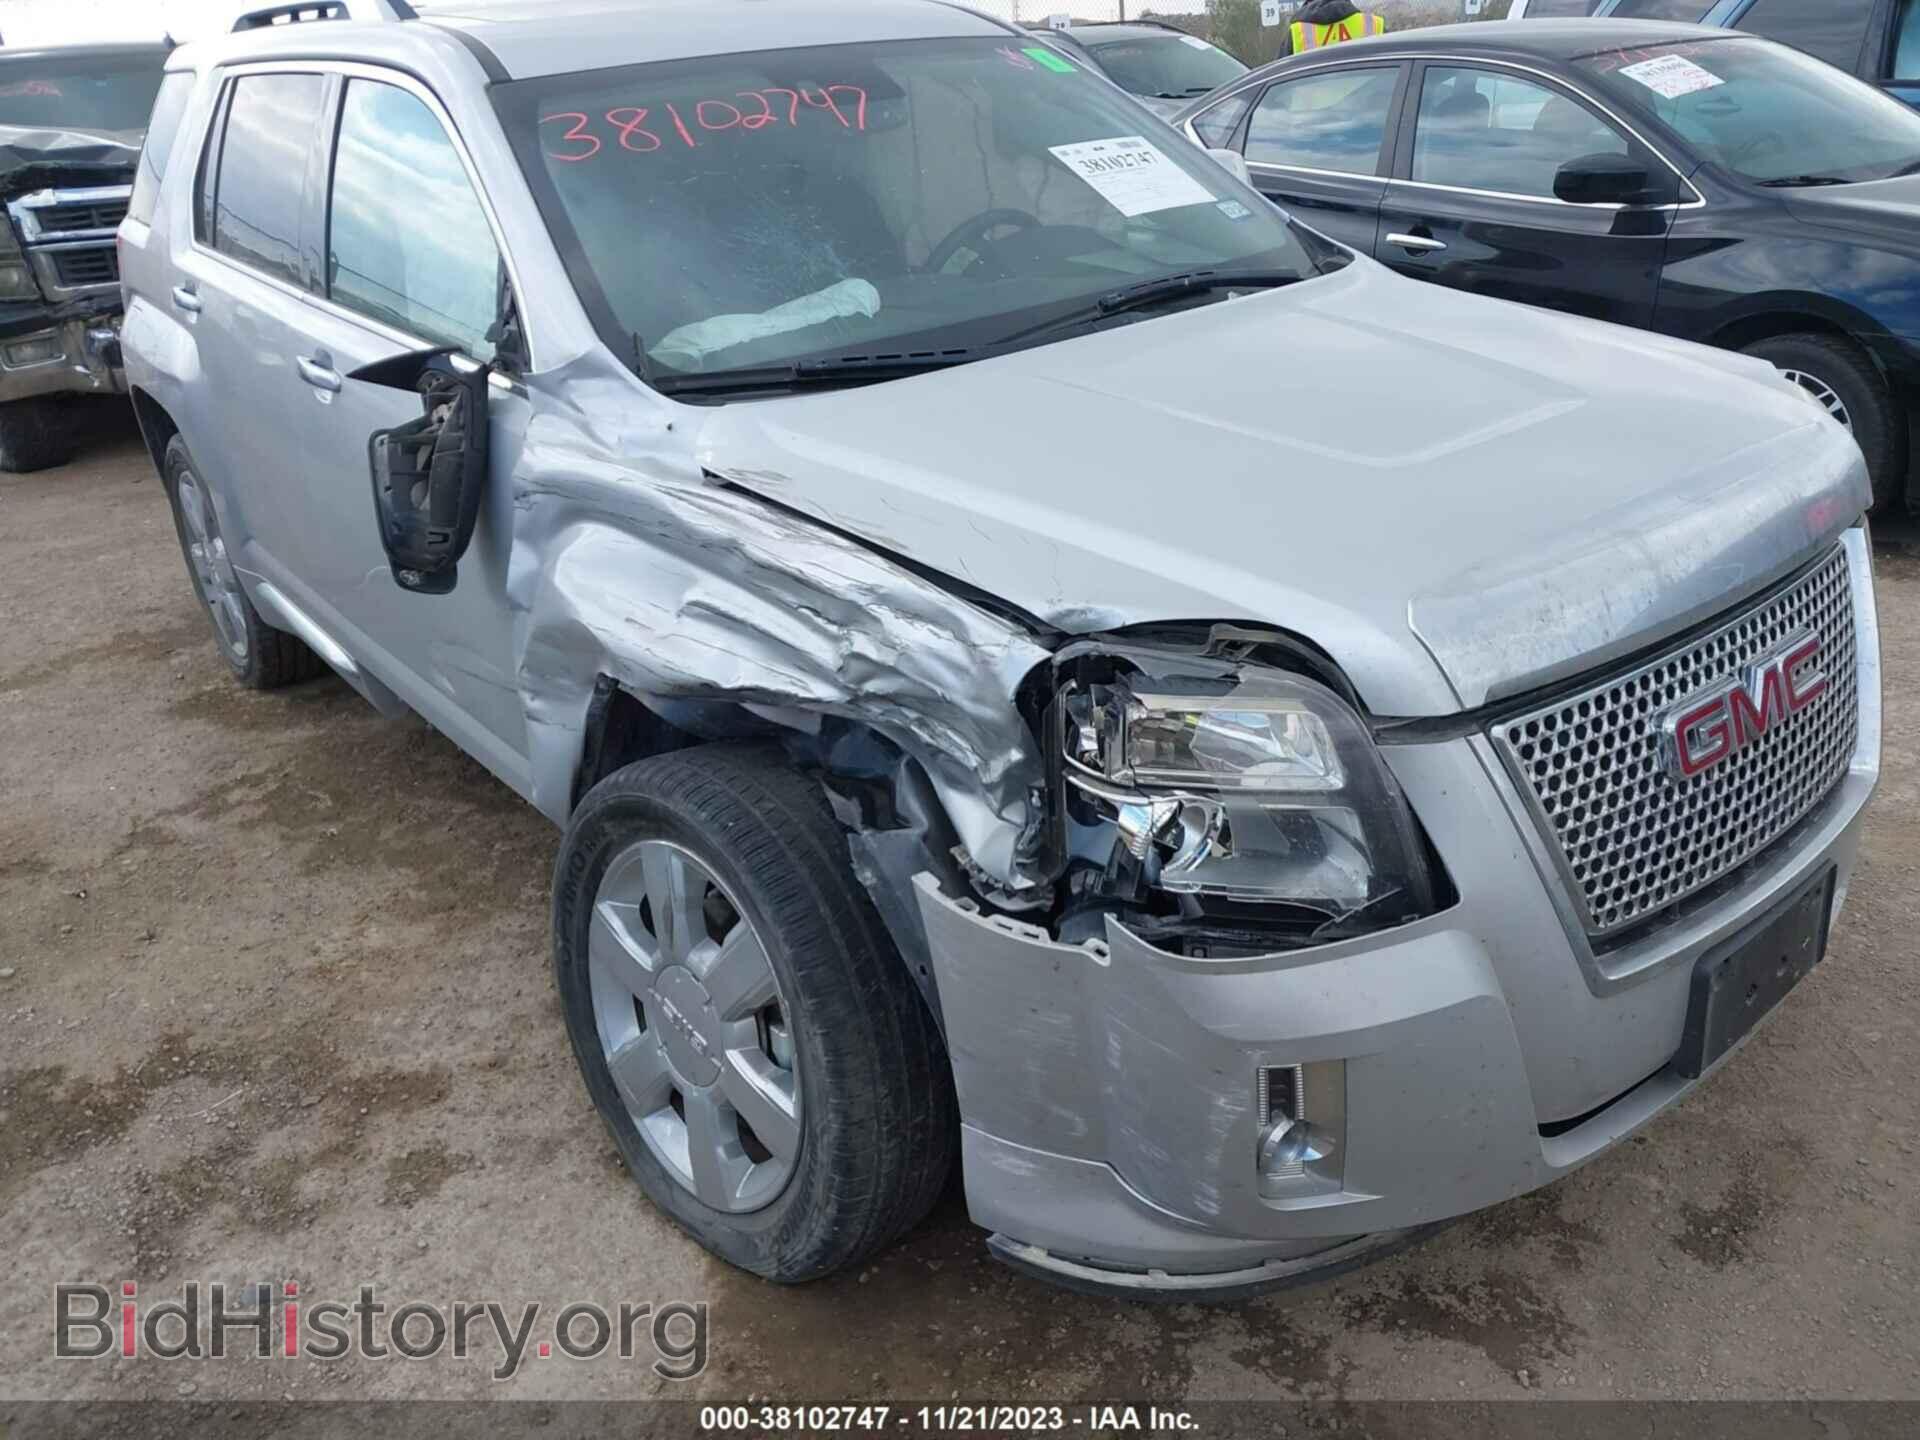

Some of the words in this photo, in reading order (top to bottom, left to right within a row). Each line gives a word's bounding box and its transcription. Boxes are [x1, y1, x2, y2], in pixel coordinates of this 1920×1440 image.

[538, 84, 867, 161] 38102747
[1078, 150, 1160, 175] 38102747
[1673, 637, 1829, 778] GMC
